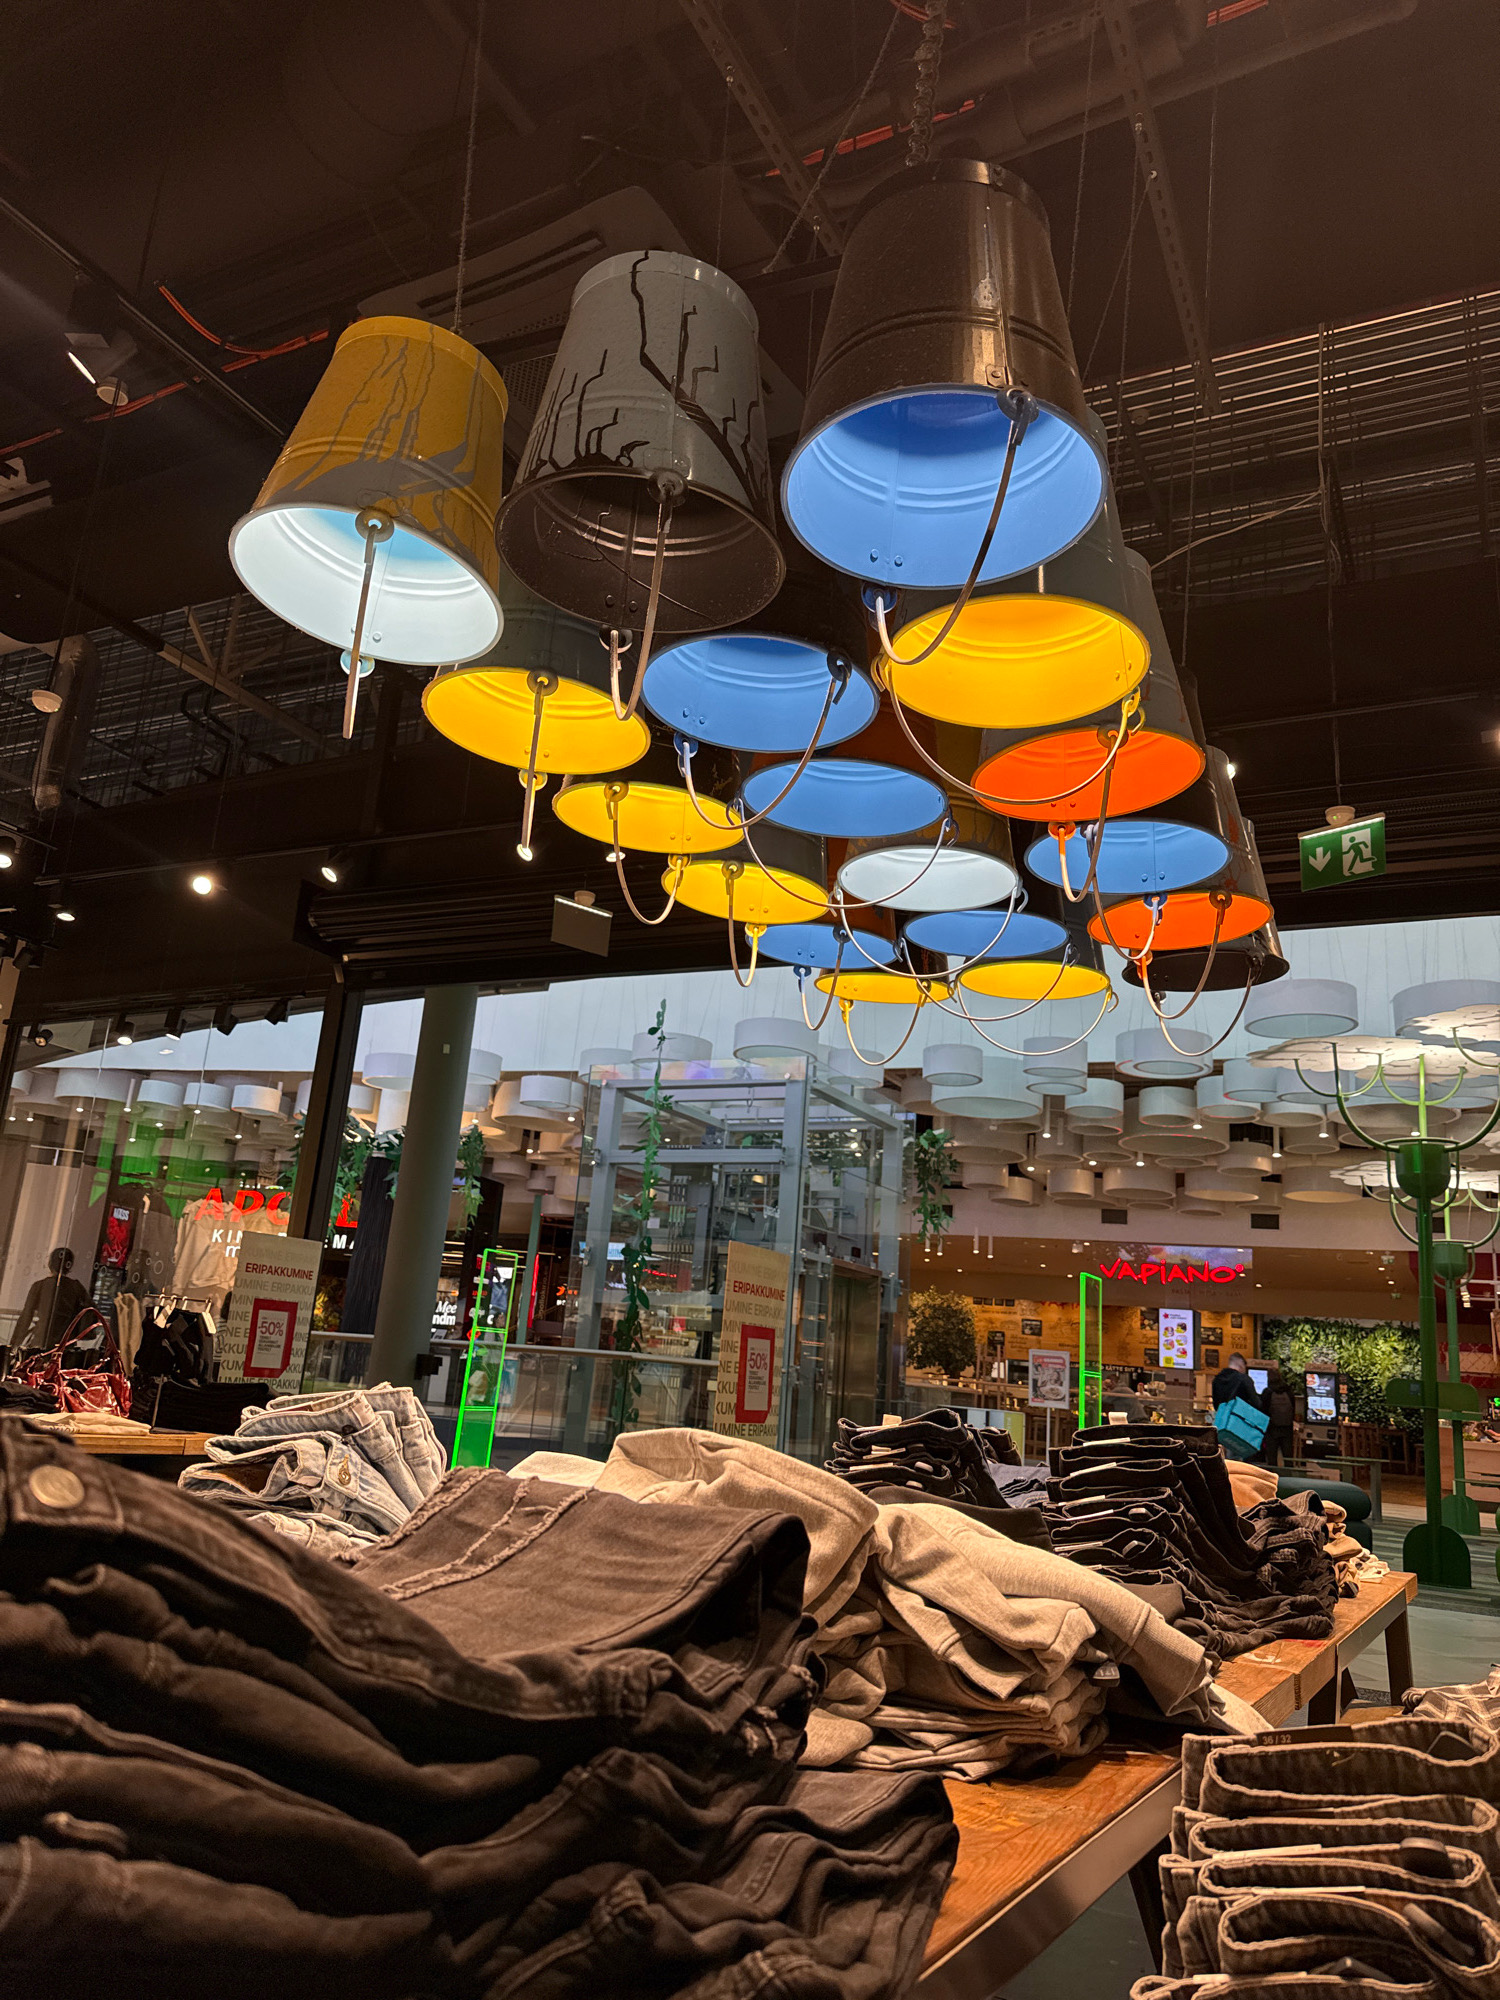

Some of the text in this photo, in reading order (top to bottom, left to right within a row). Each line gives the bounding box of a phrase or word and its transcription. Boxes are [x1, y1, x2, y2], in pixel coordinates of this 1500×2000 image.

[245, 1262, 314, 1281] ERIPAKKUMINE
[733, 1280, 785, 1301] ERIPAKKUMINE
[232, 1294, 254, 1306] MIN
[258, 1321, 284, 1336] -50%
[723, 1319, 741, 1333] MIN
[1262, 1735, 1273, 1745] 36
[1280, 1734, 1292, 1744] 32
